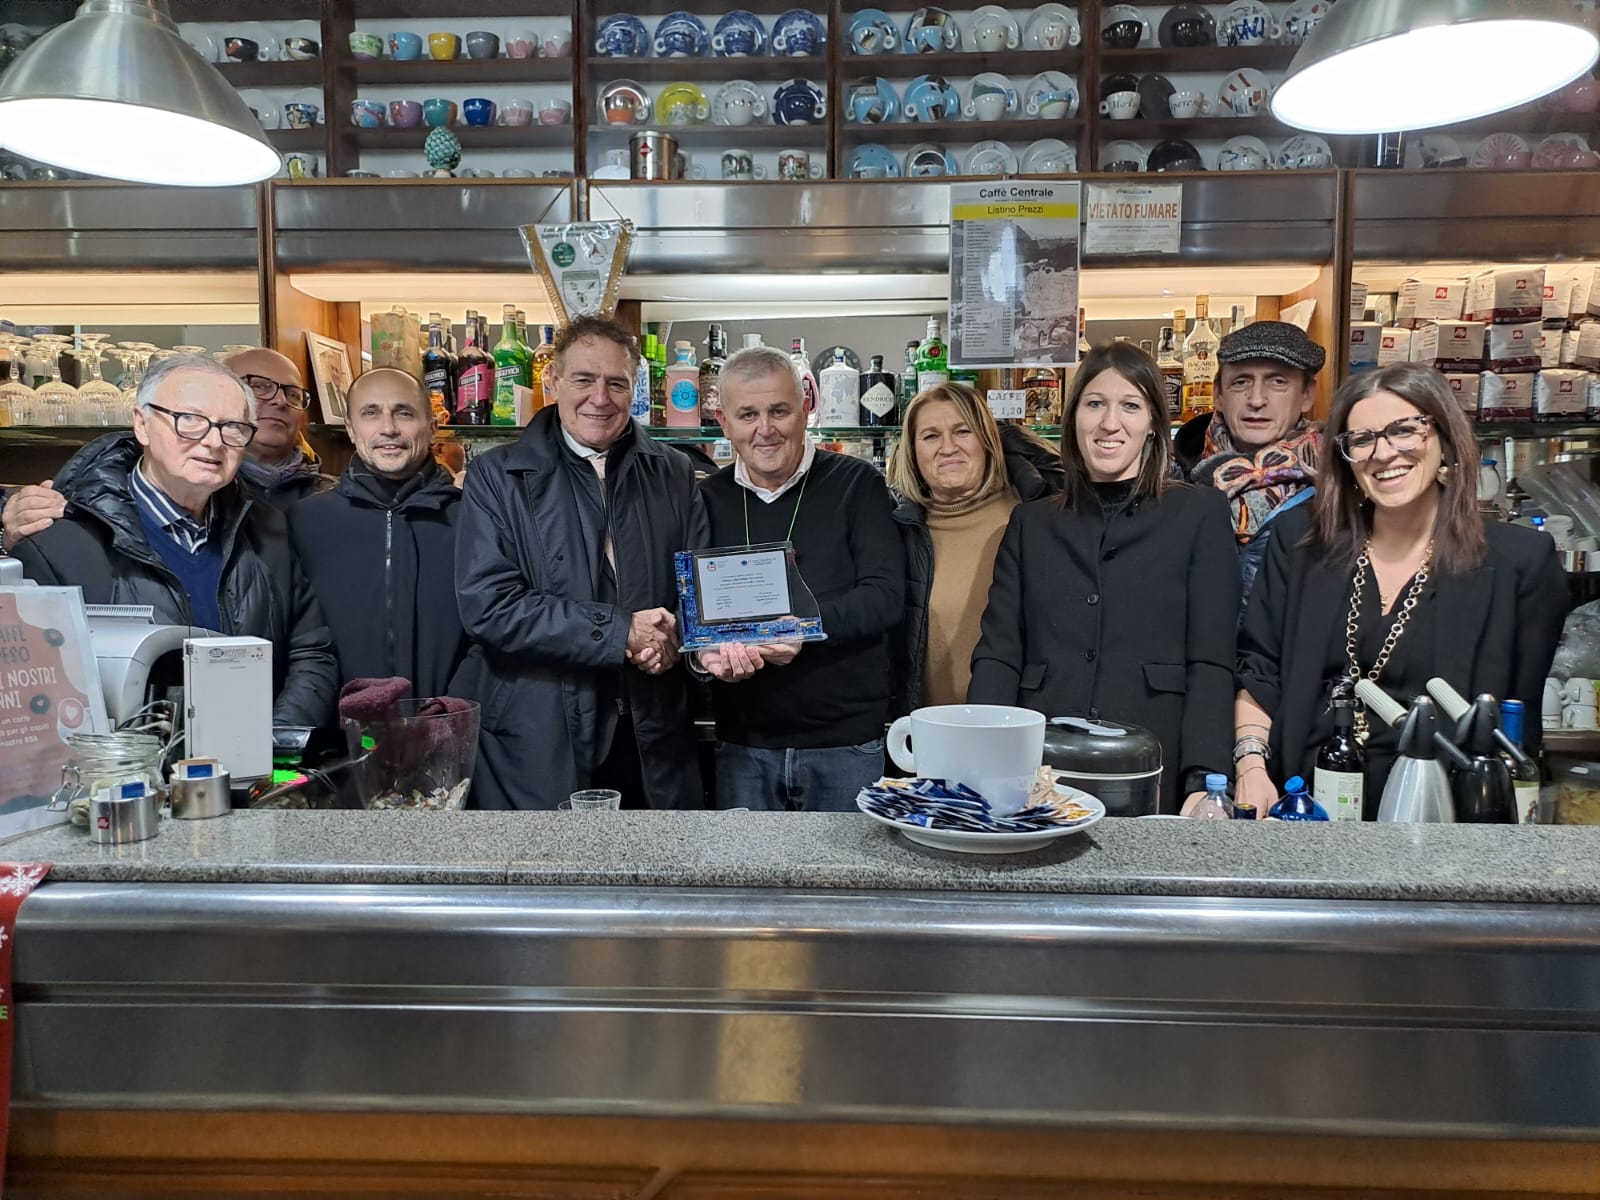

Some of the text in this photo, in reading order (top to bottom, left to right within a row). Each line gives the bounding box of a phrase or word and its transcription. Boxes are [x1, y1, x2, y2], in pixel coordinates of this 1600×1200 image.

[979, 187, 1054, 198] Caffè Centrale
[987, 204, 1044, 215] Listino Prezzi
[1089, 203, 1177, 219] VIETATO FUMARE
[1001, 407, 1023, 417] 1,20
[8, 667, 57, 688] NOSTRI
